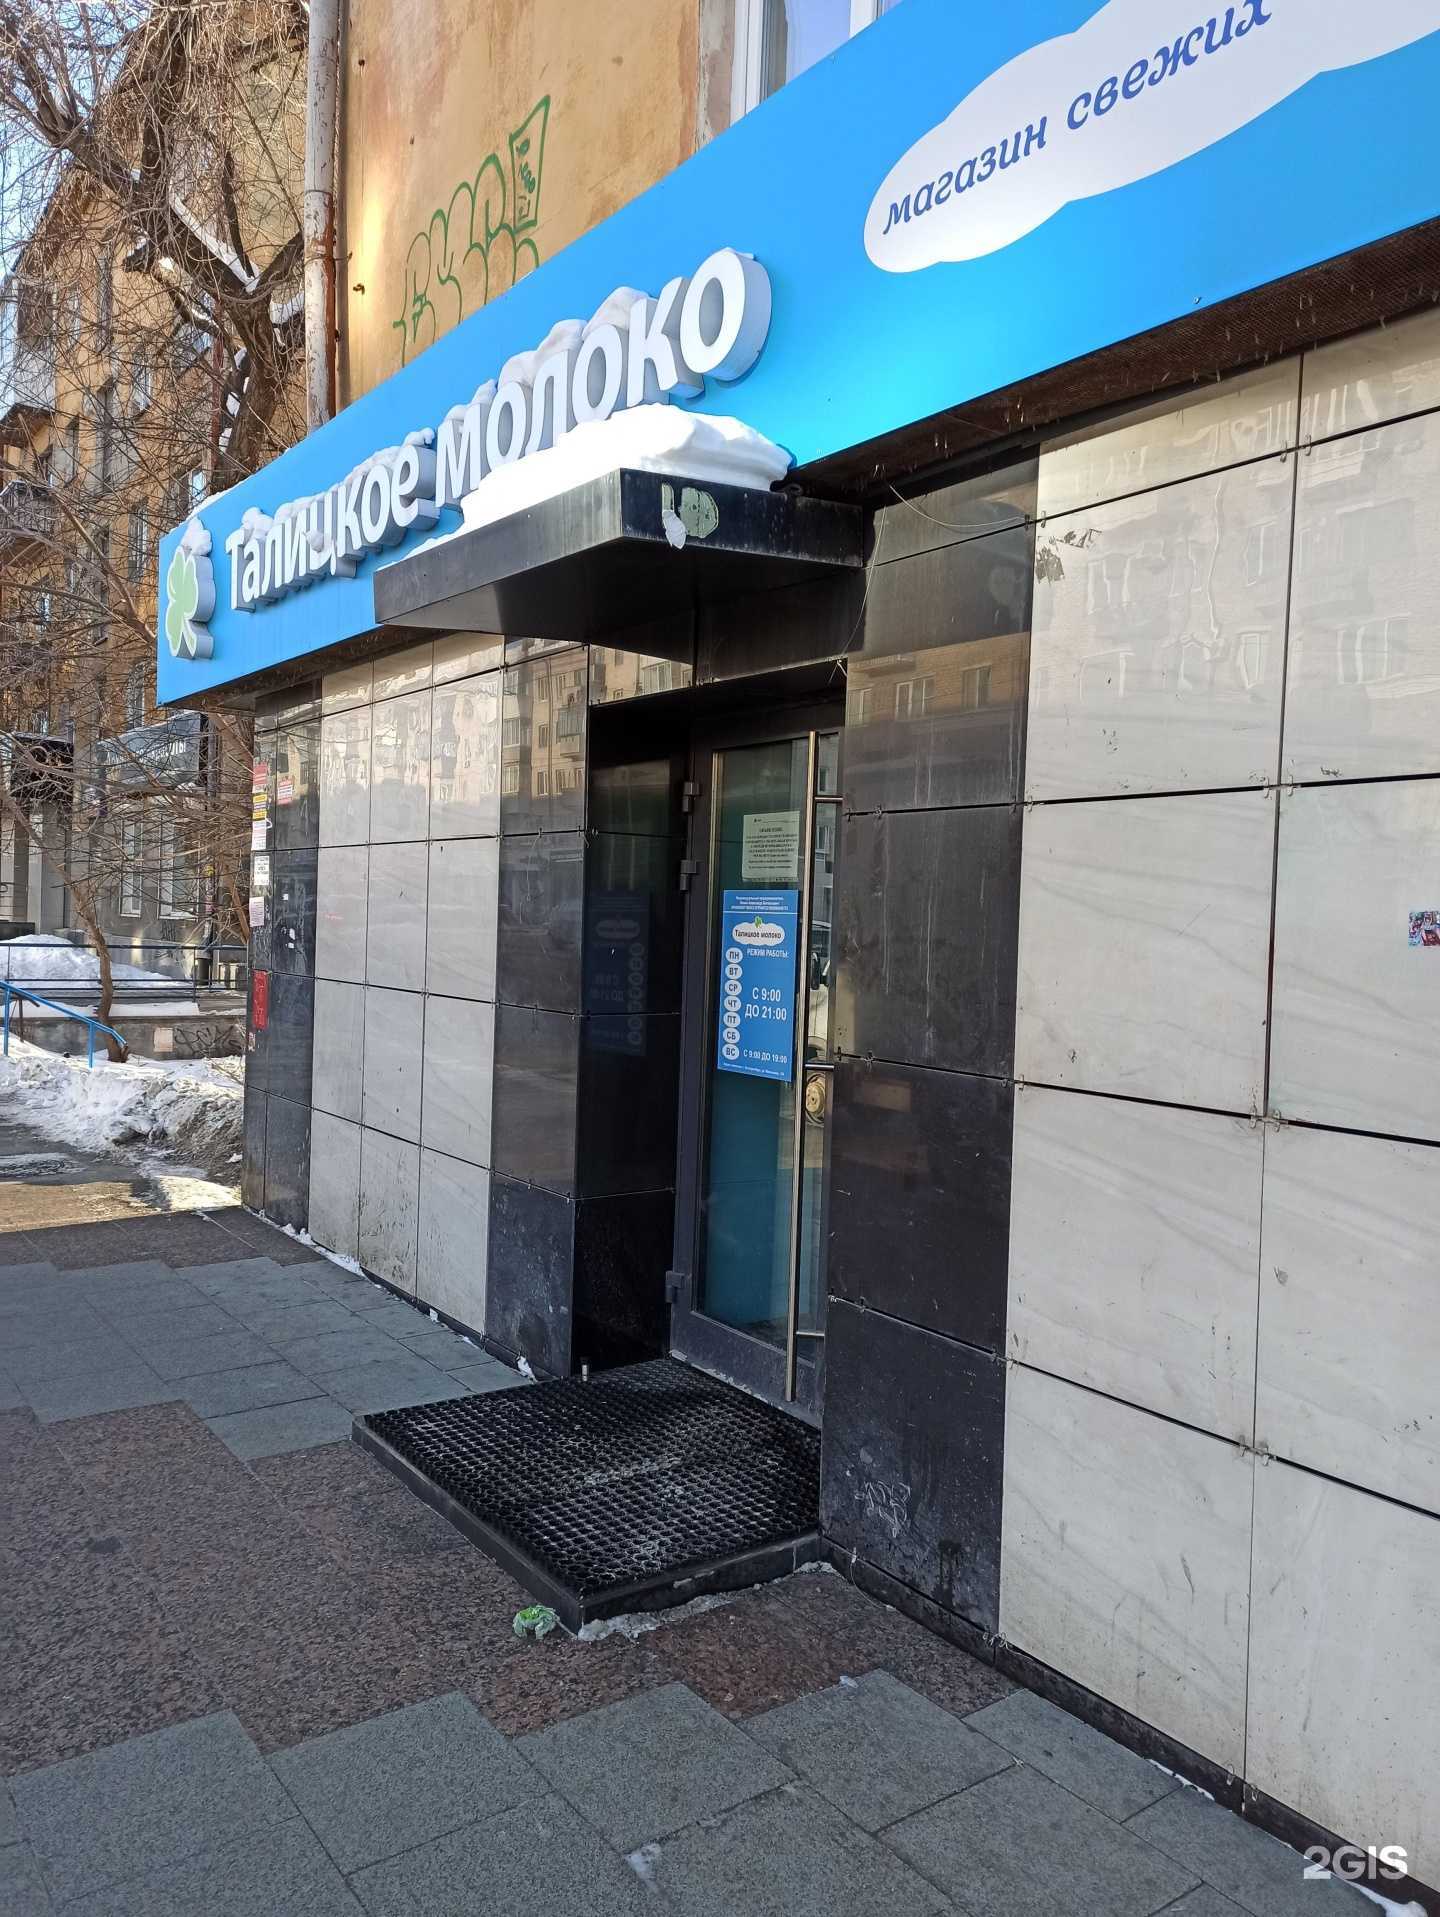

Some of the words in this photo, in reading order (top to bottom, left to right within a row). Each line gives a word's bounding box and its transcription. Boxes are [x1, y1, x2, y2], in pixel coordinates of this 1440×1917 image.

[882, 115, 1048, 236] магазин
[1066, 0, 1272, 131] свежих
[225, 446, 432, 611] Талицкое
[434, 248, 765, 508] молоко
[735, 929, 760, 938] Талицкое
[761, 931, 782, 939] молоко
[729, 951, 740, 960] ПН
[747, 948, 766, 957] РЕЖИМ
[729, 967, 739, 976] ВТ
[728, 984, 738, 992] СР
[752, 987, 759, 1000] С
[761, 987, 781, 1002] 9:00
[728, 1000, 737, 1008] ЧТ
[744, 1003, 760, 1018] ДО
[761, 1006, 787, 1021] 21:00
[727, 1015, 737, 1024] ПТ
[726, 1031, 736, 1040] СБ
[726, 1047, 736, 1056] ВС
[761, 1052, 771, 1061] ДО
